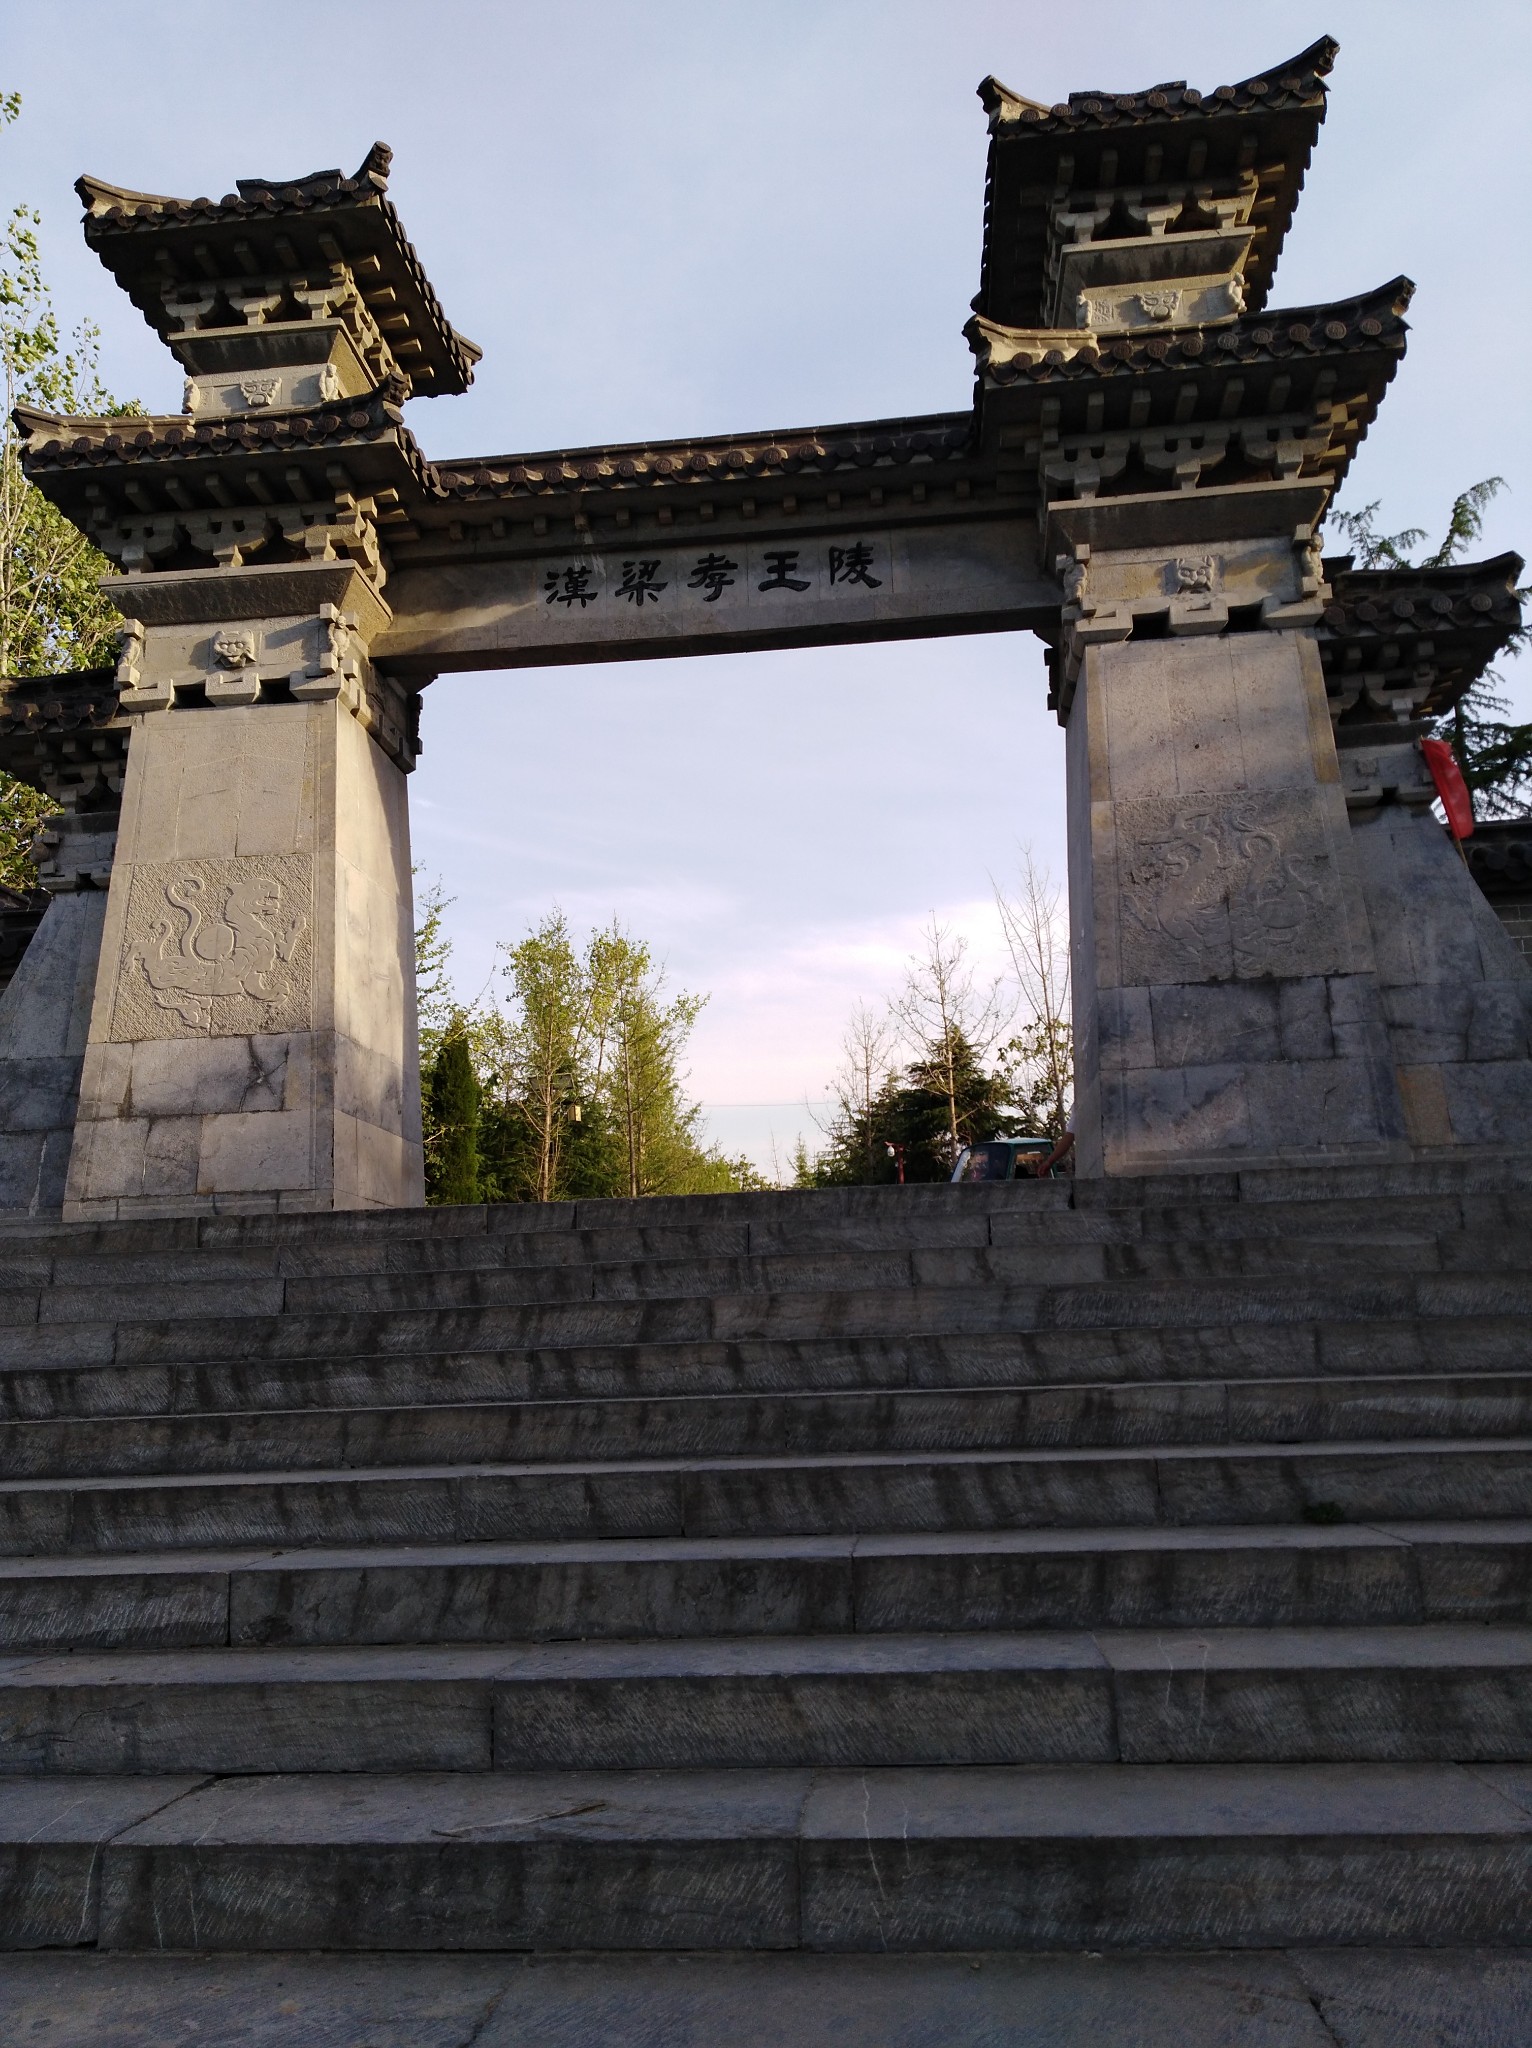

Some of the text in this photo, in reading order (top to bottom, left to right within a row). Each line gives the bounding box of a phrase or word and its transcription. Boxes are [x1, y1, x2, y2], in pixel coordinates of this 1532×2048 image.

[544, 541, 882, 608] 漢梁孝王陵
